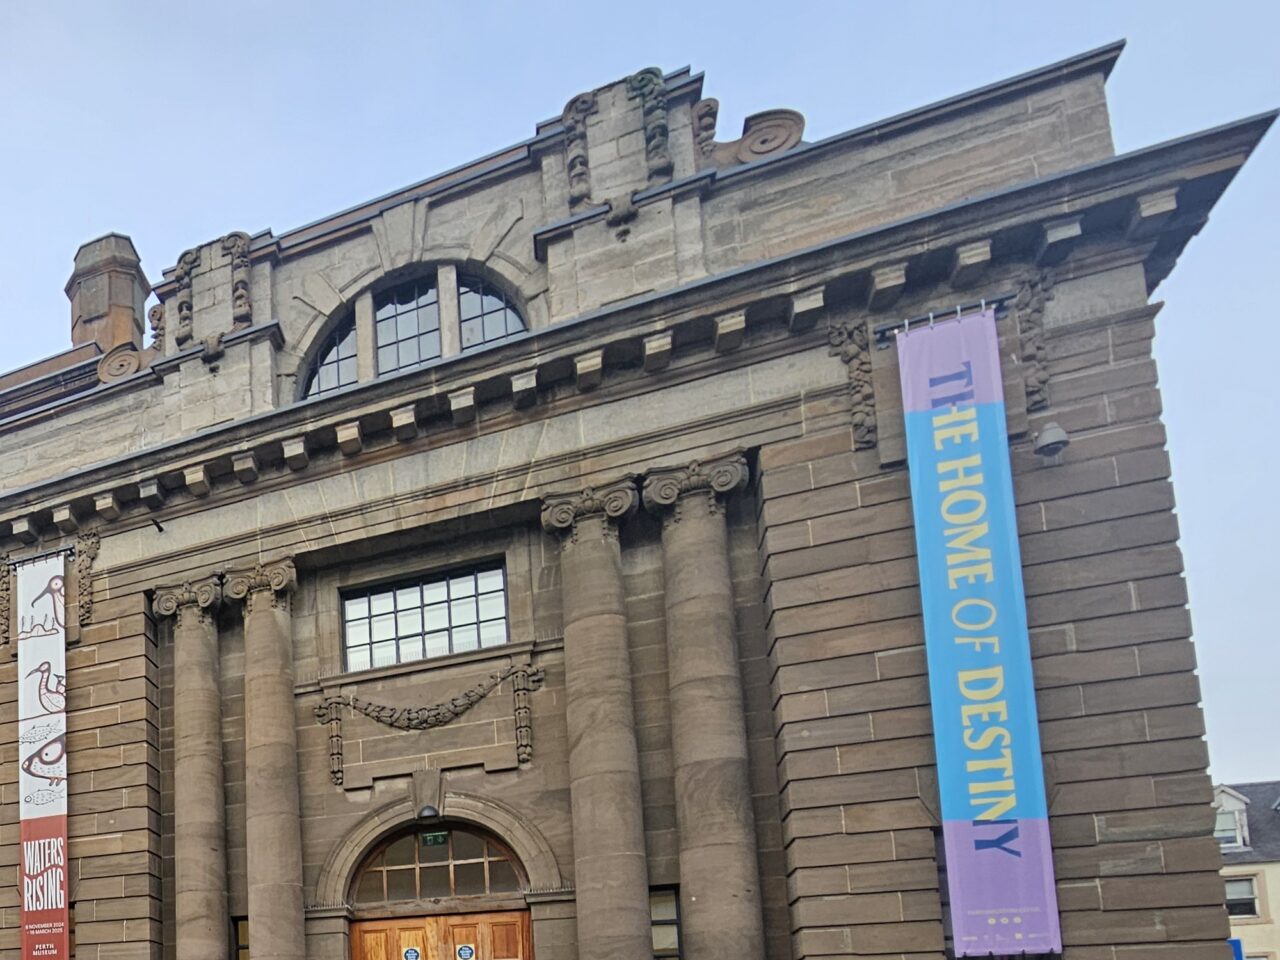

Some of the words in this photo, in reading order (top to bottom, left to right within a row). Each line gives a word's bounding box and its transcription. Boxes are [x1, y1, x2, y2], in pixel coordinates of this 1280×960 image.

[928, 360, 980, 451] THE
[936, 453, 995, 590] HOME
[951, 598, 1001, 655] OF
[957, 665, 1022, 859] DESTINY
[23, 836, 64, 876] WATERS
[23, 867, 65, 912] RISING
